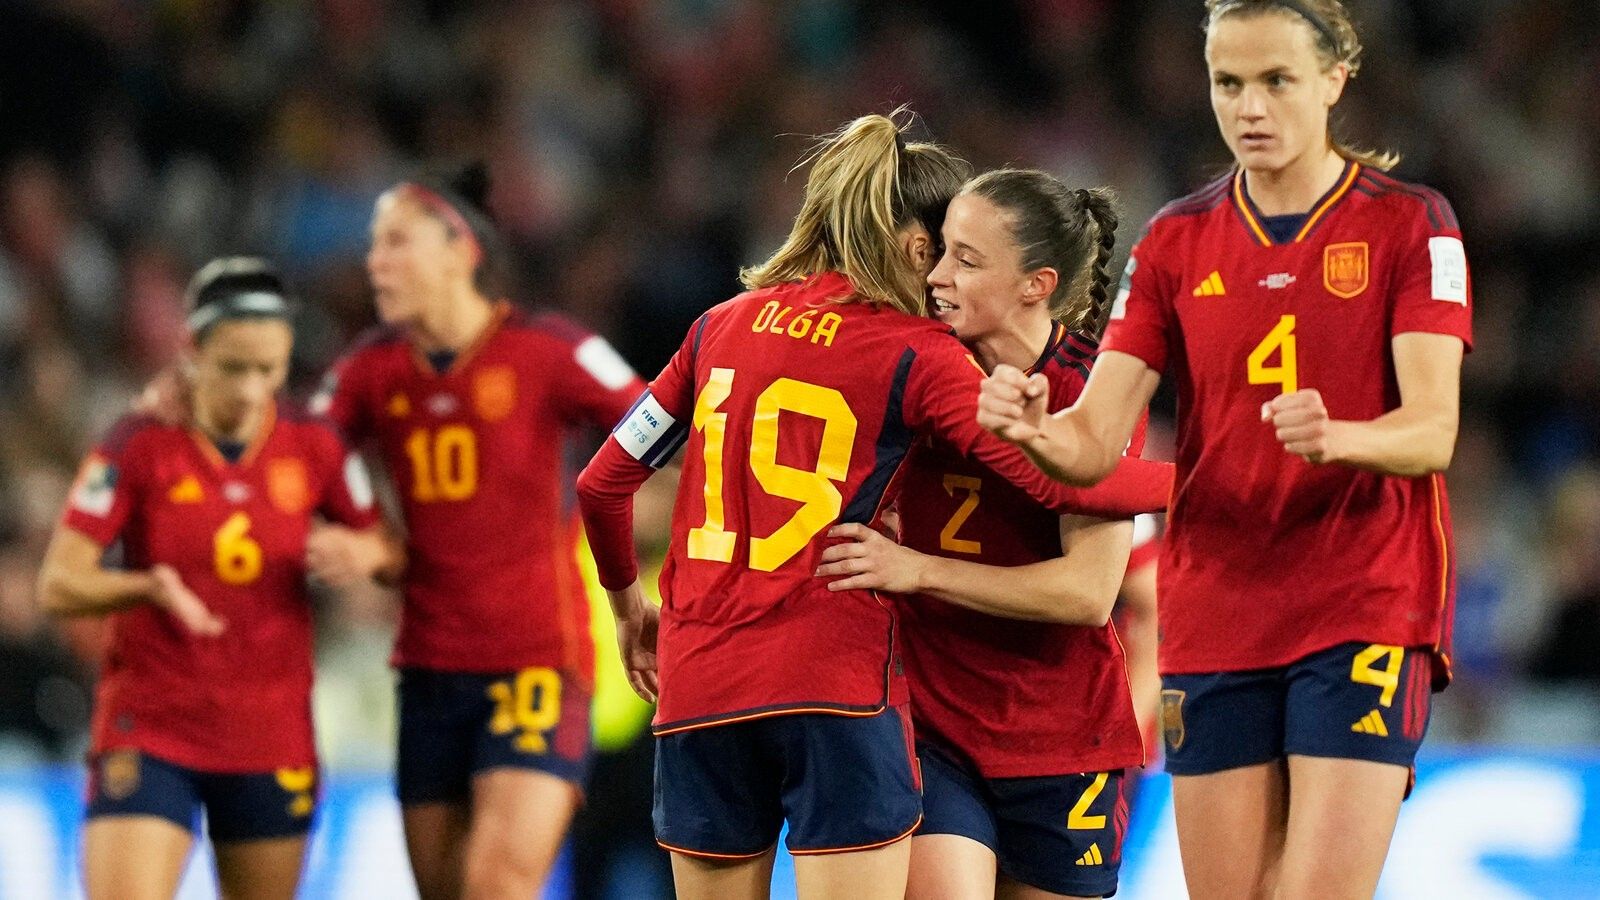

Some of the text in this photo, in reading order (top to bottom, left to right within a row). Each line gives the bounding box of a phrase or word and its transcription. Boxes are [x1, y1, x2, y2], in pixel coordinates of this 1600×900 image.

[751, 300, 843, 347] OLGA
[1247, 314, 1298, 394] 4
[641, 409, 659, 428] FIFA
[405, 425, 477, 501] 10
[687, 367, 858, 573] 19
[214, 510, 262, 585] 6
[940, 473, 982, 554] 2
[486, 667, 562, 734] 10
[1351, 643, 1405, 709] 4
[1066, 771, 1109, 830] 2
